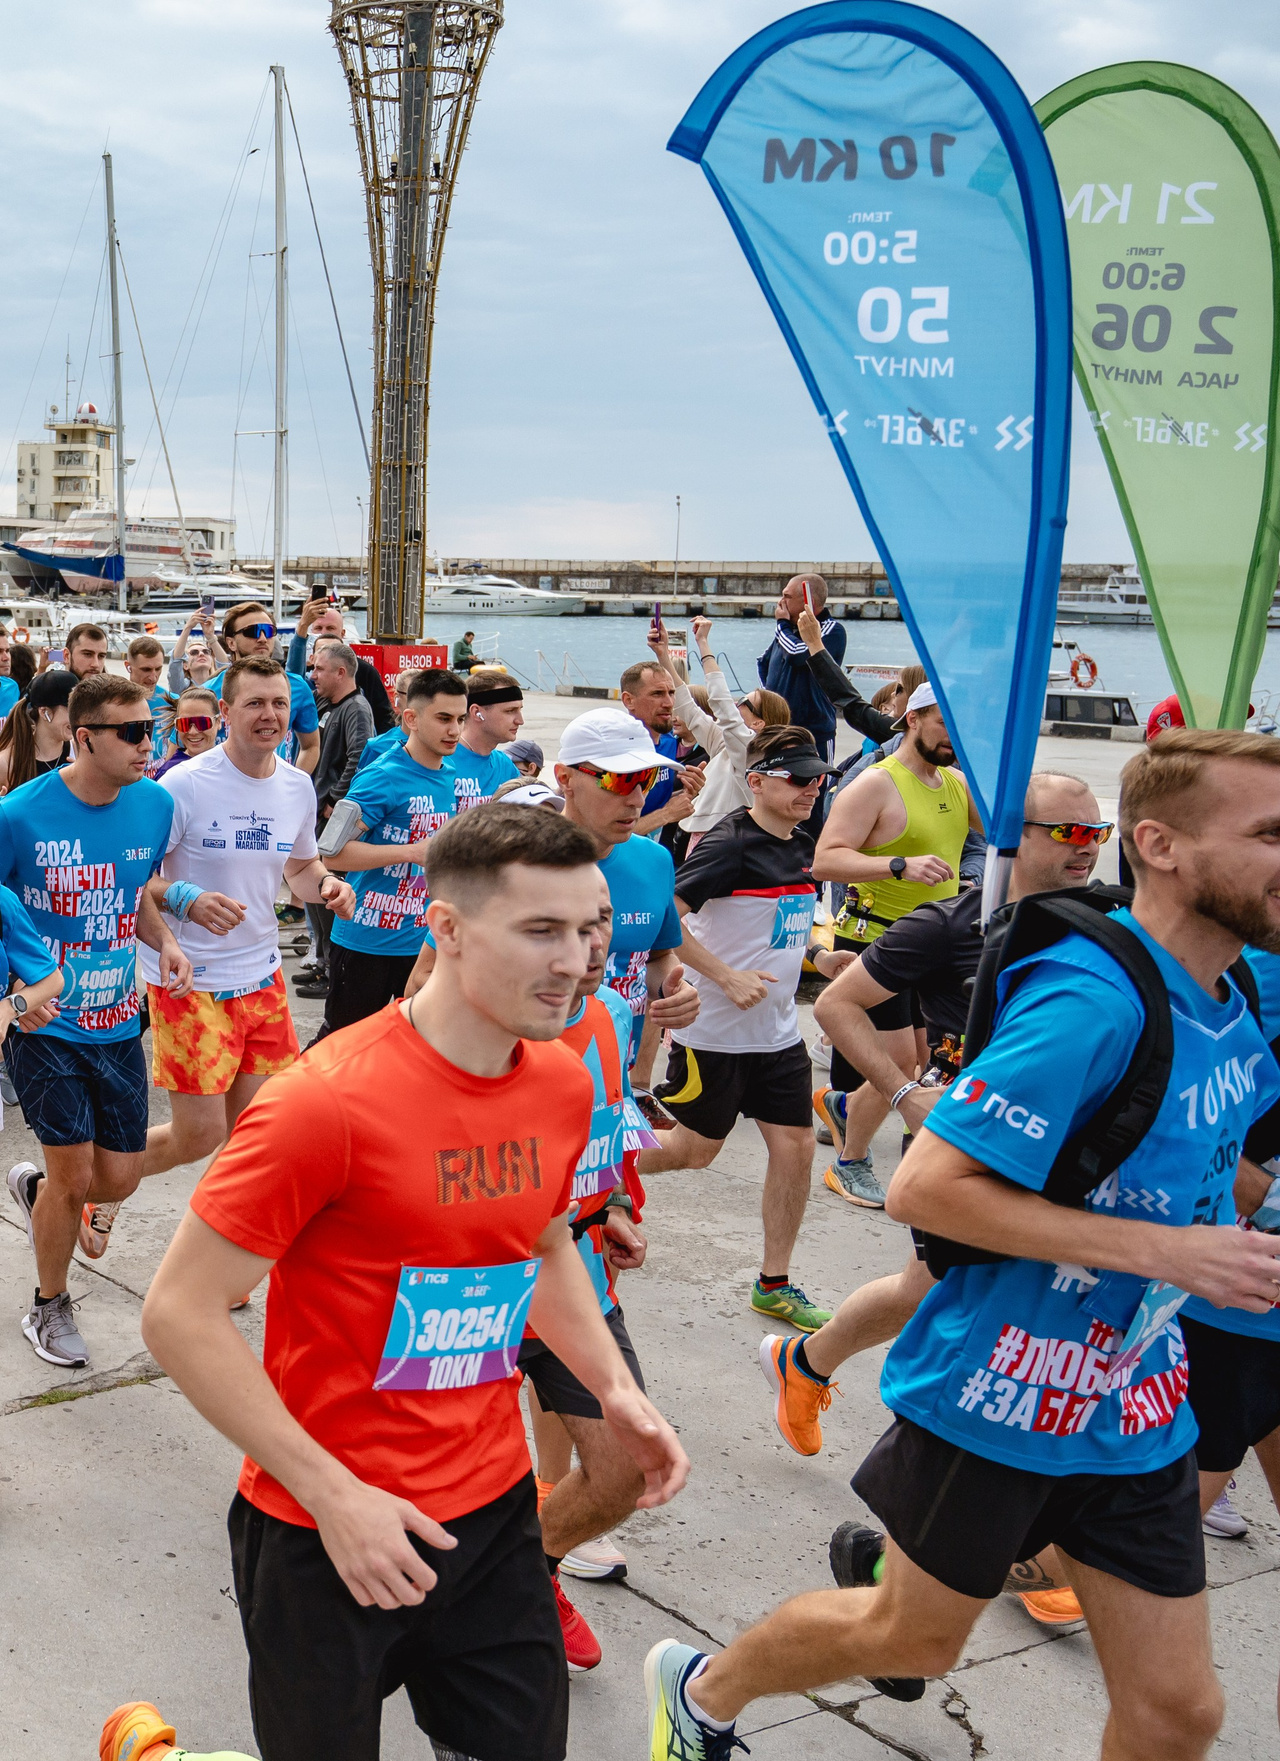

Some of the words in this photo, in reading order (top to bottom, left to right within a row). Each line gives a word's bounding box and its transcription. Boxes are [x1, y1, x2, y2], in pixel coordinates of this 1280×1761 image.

[399, 655, 432, 668] ВЫЗОВ
[454, 778, 482, 797] 2024
[407, 795, 435, 814] 2024
[35, 838, 84, 866] 2024
[235, 841, 270, 851] MARATONU
[45, 862, 116, 891] #МЕЧТА
[23, 884, 125, 918] #ЗАБЕГ2024
[363, 890, 427, 916] #ЛЮБОВЬ
[354, 907, 405, 930] #ЗАБЕГ
[78, 966, 124, 990] 40081
[983, 1094, 1050, 1140] ПСБ
[434, 1136, 543, 1205] RUN
[1201, 1140, 1238, 1184] :00
[569, 1170, 599, 1200] 0КМ
[424, 1273, 449, 1284] ПСБ
[415, 1303, 510, 1351] 30254
[987, 1323, 1141, 1397] #ЛЮБ
[956, 1367, 1102, 1437] #ЗАБЕГ
